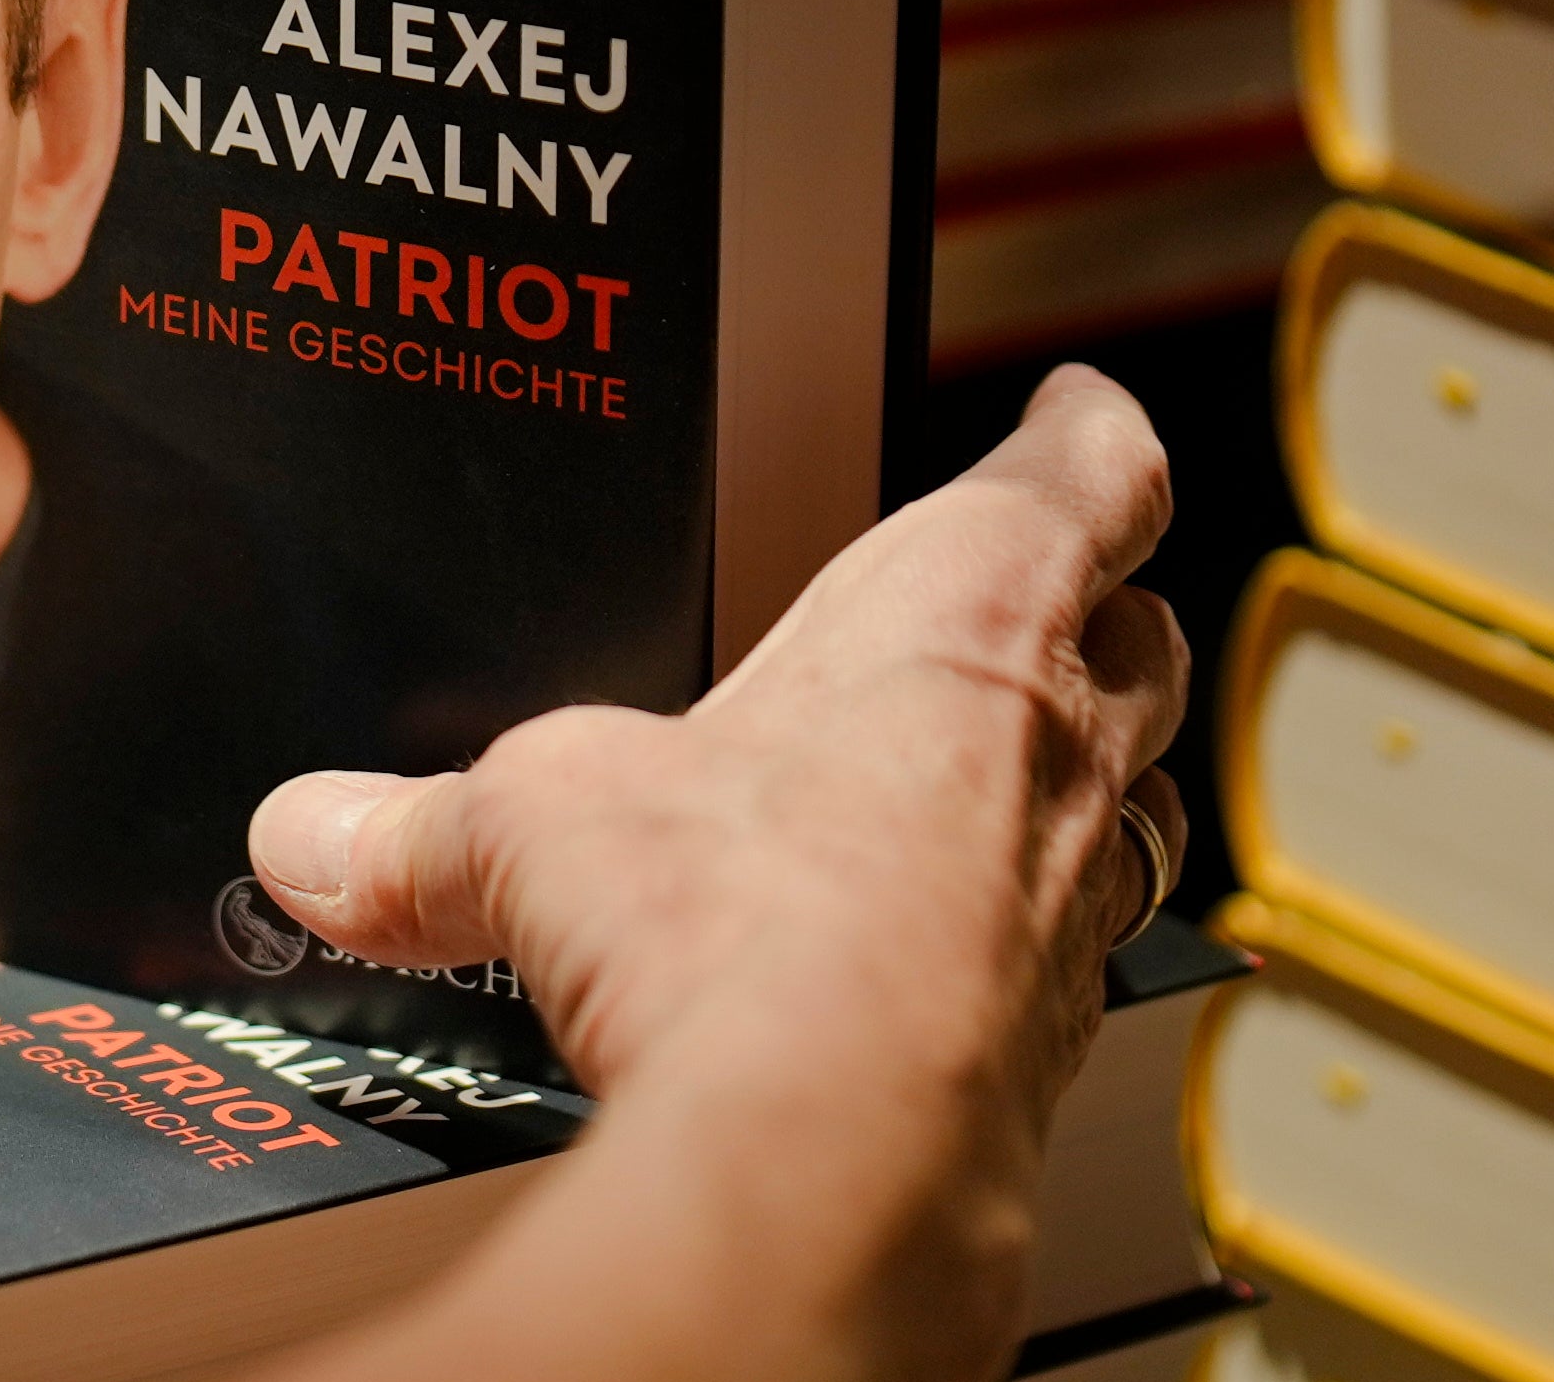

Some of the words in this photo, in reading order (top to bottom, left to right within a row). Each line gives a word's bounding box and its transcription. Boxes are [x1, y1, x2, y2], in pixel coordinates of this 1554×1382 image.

[144, 67, 632, 225] NAWALNY
[219, 207, 630, 352] PATRIOT
[118, 284, 269, 353] MEINE
[289, 320, 627, 419] GESCHICHTE
[19, 1045, 255, 1173] GESCHICHTE
[29, 1002, 341, 1152] PATRIOT
[156, 1003, 450, 1125] WALNY
